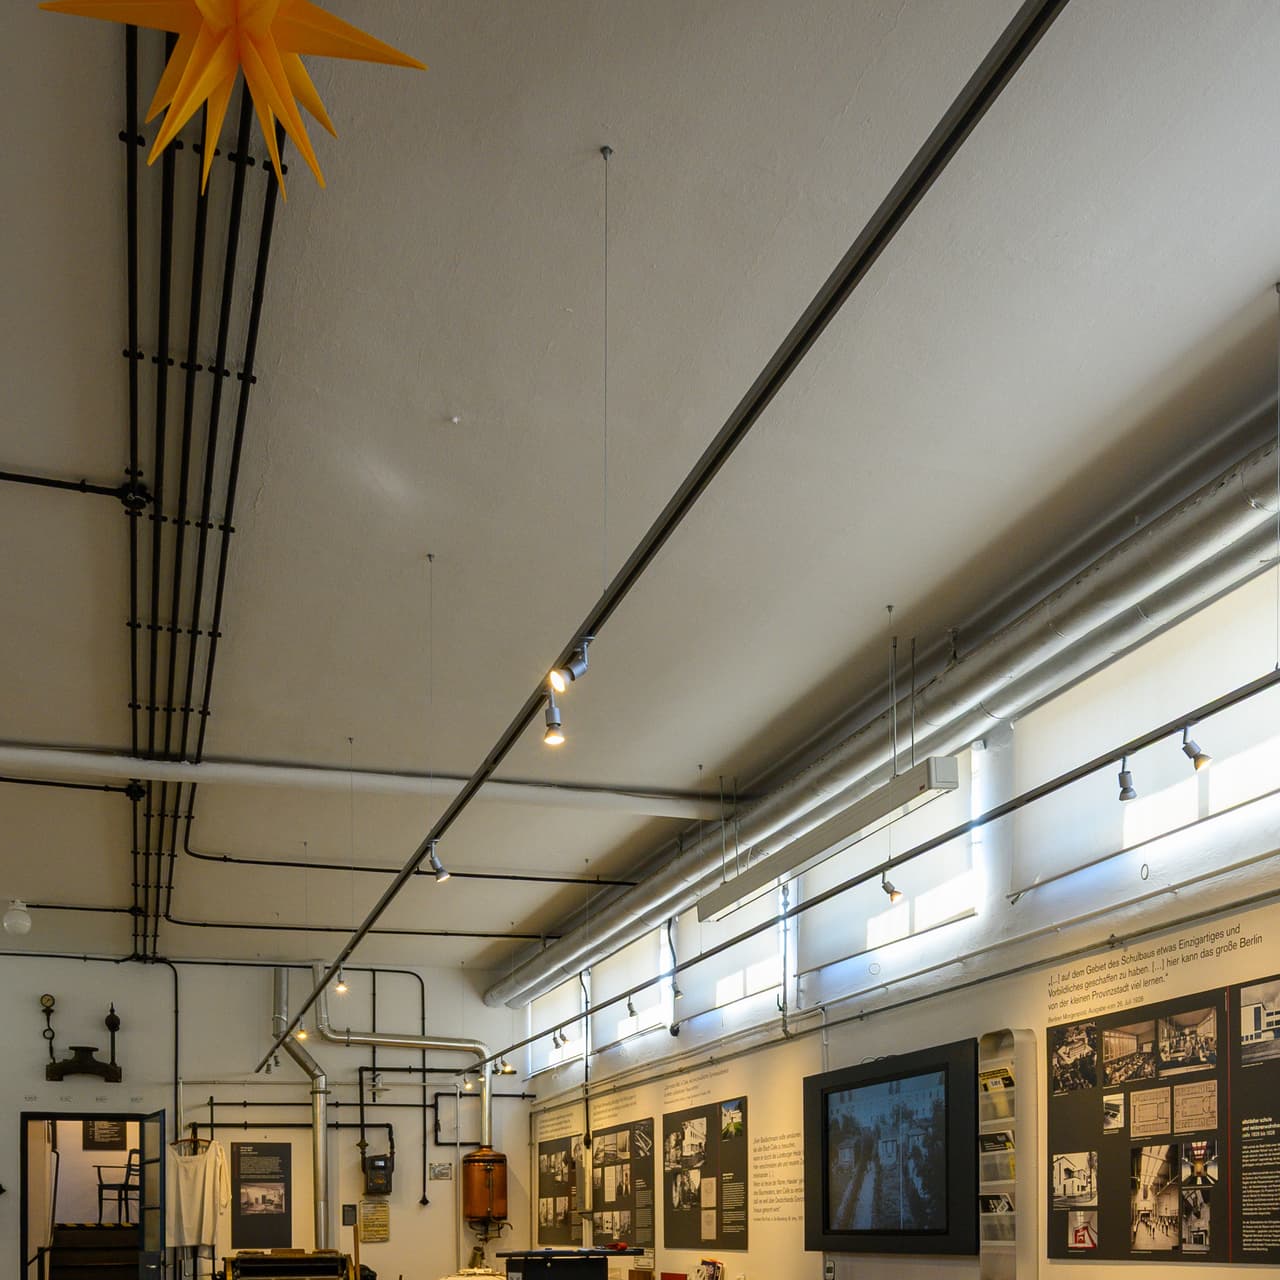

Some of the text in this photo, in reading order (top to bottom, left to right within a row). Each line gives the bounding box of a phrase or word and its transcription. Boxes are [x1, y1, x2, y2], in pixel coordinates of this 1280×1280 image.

[1048, 982, 1083, 998] Vorbildliches
[1084, 973, 1118, 990] geschaffen
[1119, 971, 1127, 980] zu
[1166, 957, 1180, 969] hier
[1181, 951, 1198, 964] kann
[1200, 948, 1214, 960] das
[1215, 942, 1238, 957] große
[1239, 934, 1263, 949] Berlin
[1086, 962, 1107, 976] Gebiet
[1107, 958, 1120, 969] des
[1121, 949, 1155, 967] Schulbaus
[1156, 943, 1177, 958] etwas
[1178, 930, 1225, 951] Einzigartiges
[1226, 924, 1241, 937] und
[1091, 985, 1129, 999] Provinzstadt
[1130, 981, 1141, 991] viel
